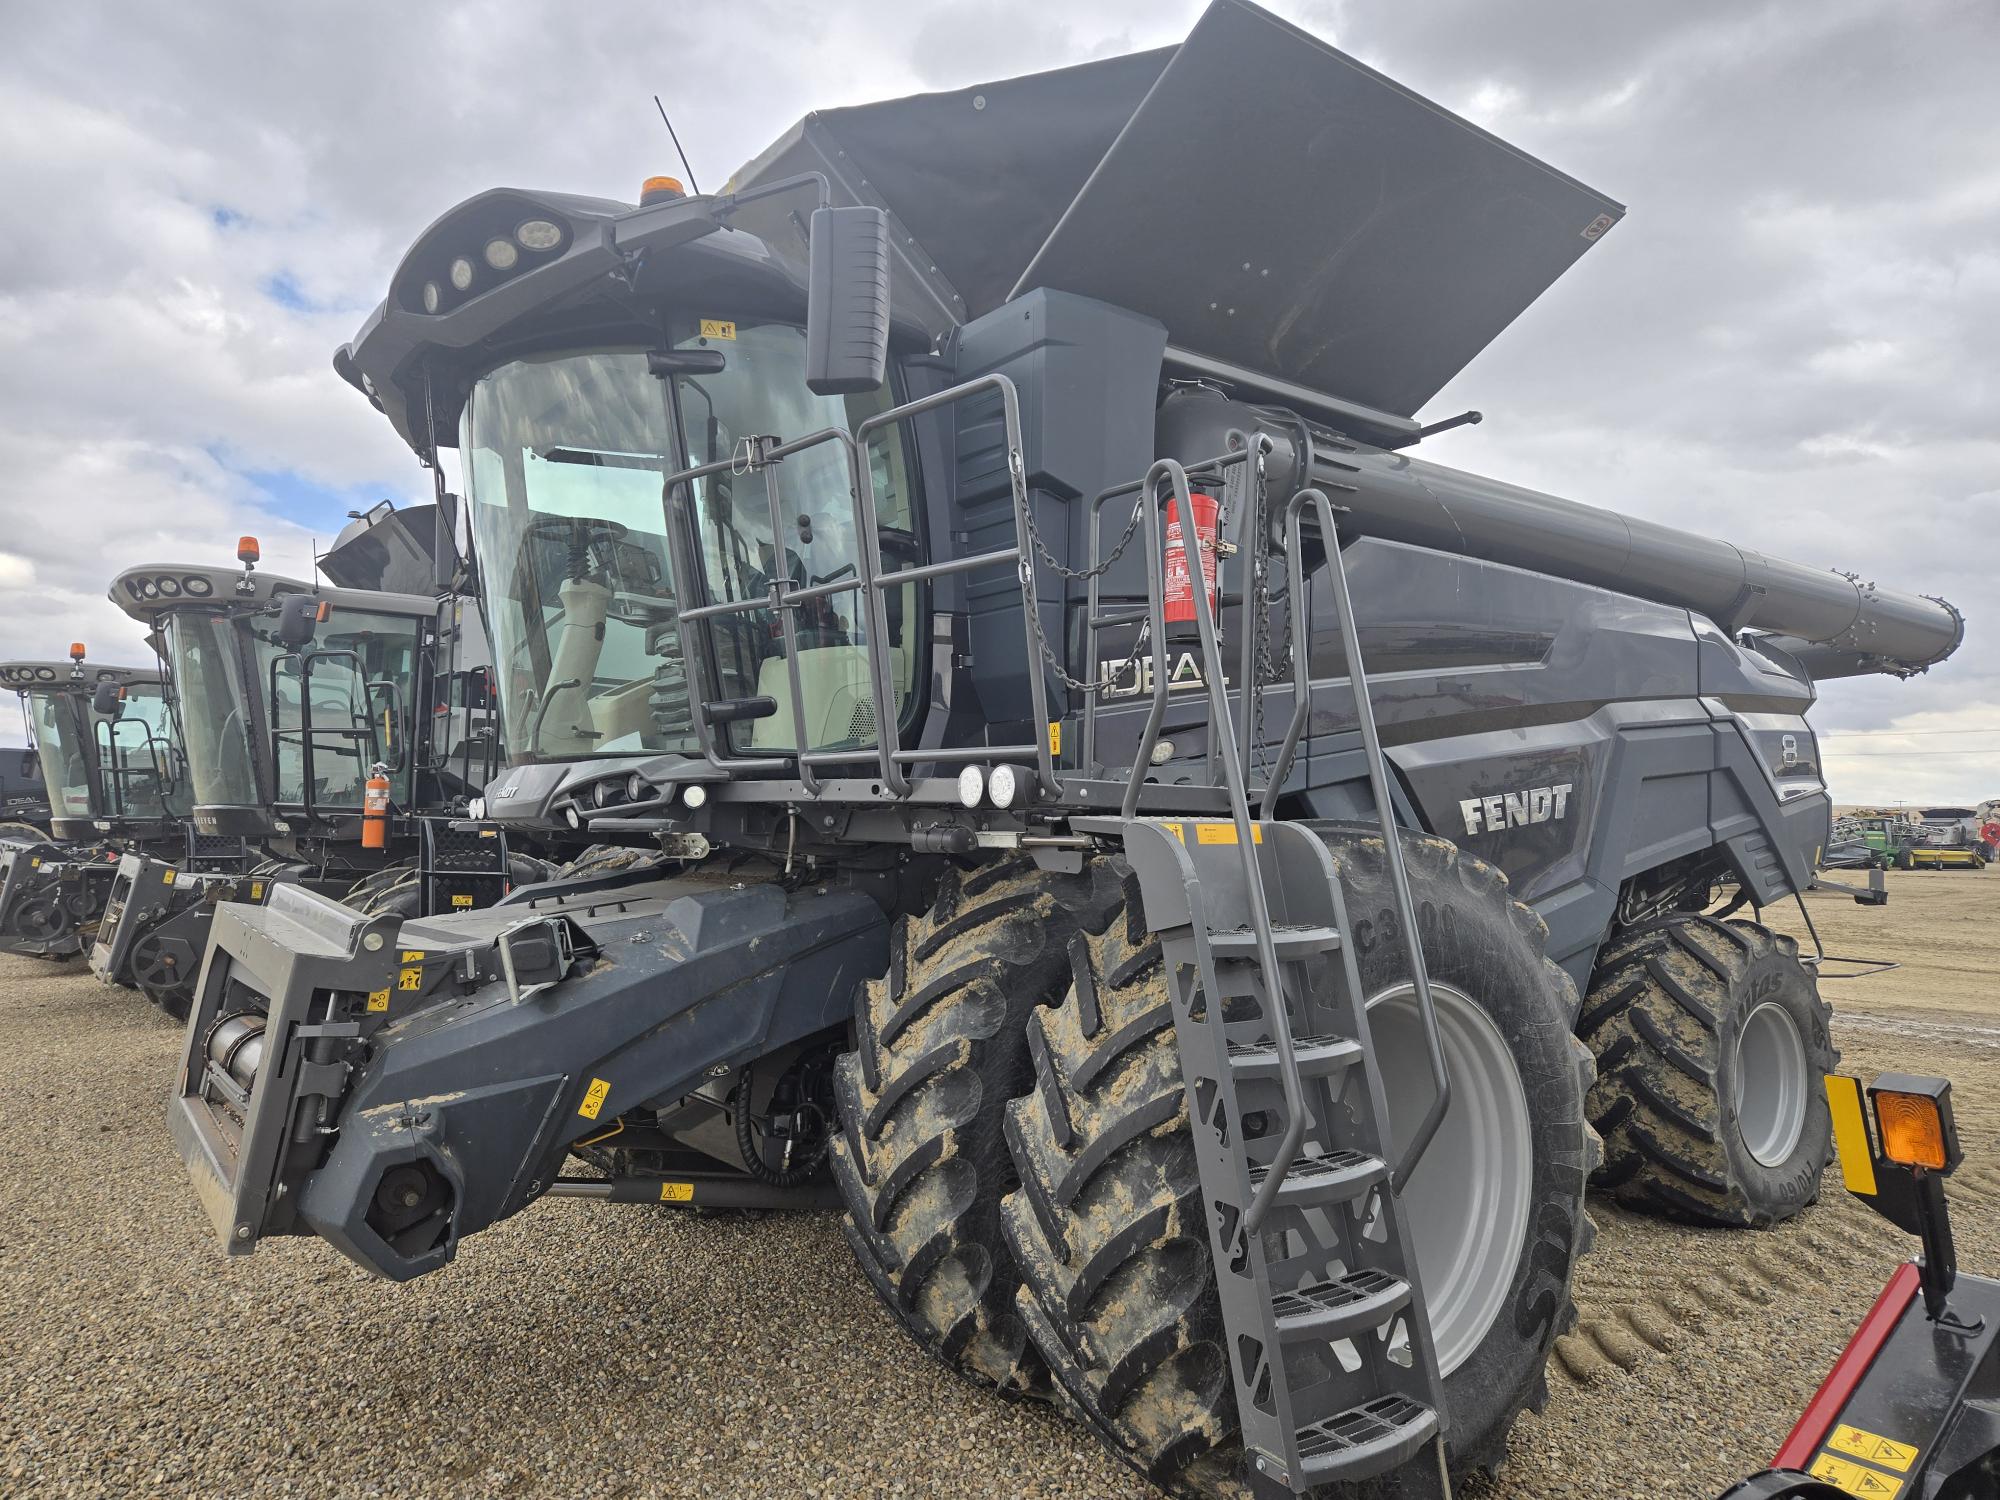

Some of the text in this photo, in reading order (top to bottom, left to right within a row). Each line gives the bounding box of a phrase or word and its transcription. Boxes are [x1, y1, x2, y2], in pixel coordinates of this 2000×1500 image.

[1100, 653, 1230, 700] IDEA
[1782, 734, 1798, 768] 8
[1459, 783, 1573, 836] FENDT
